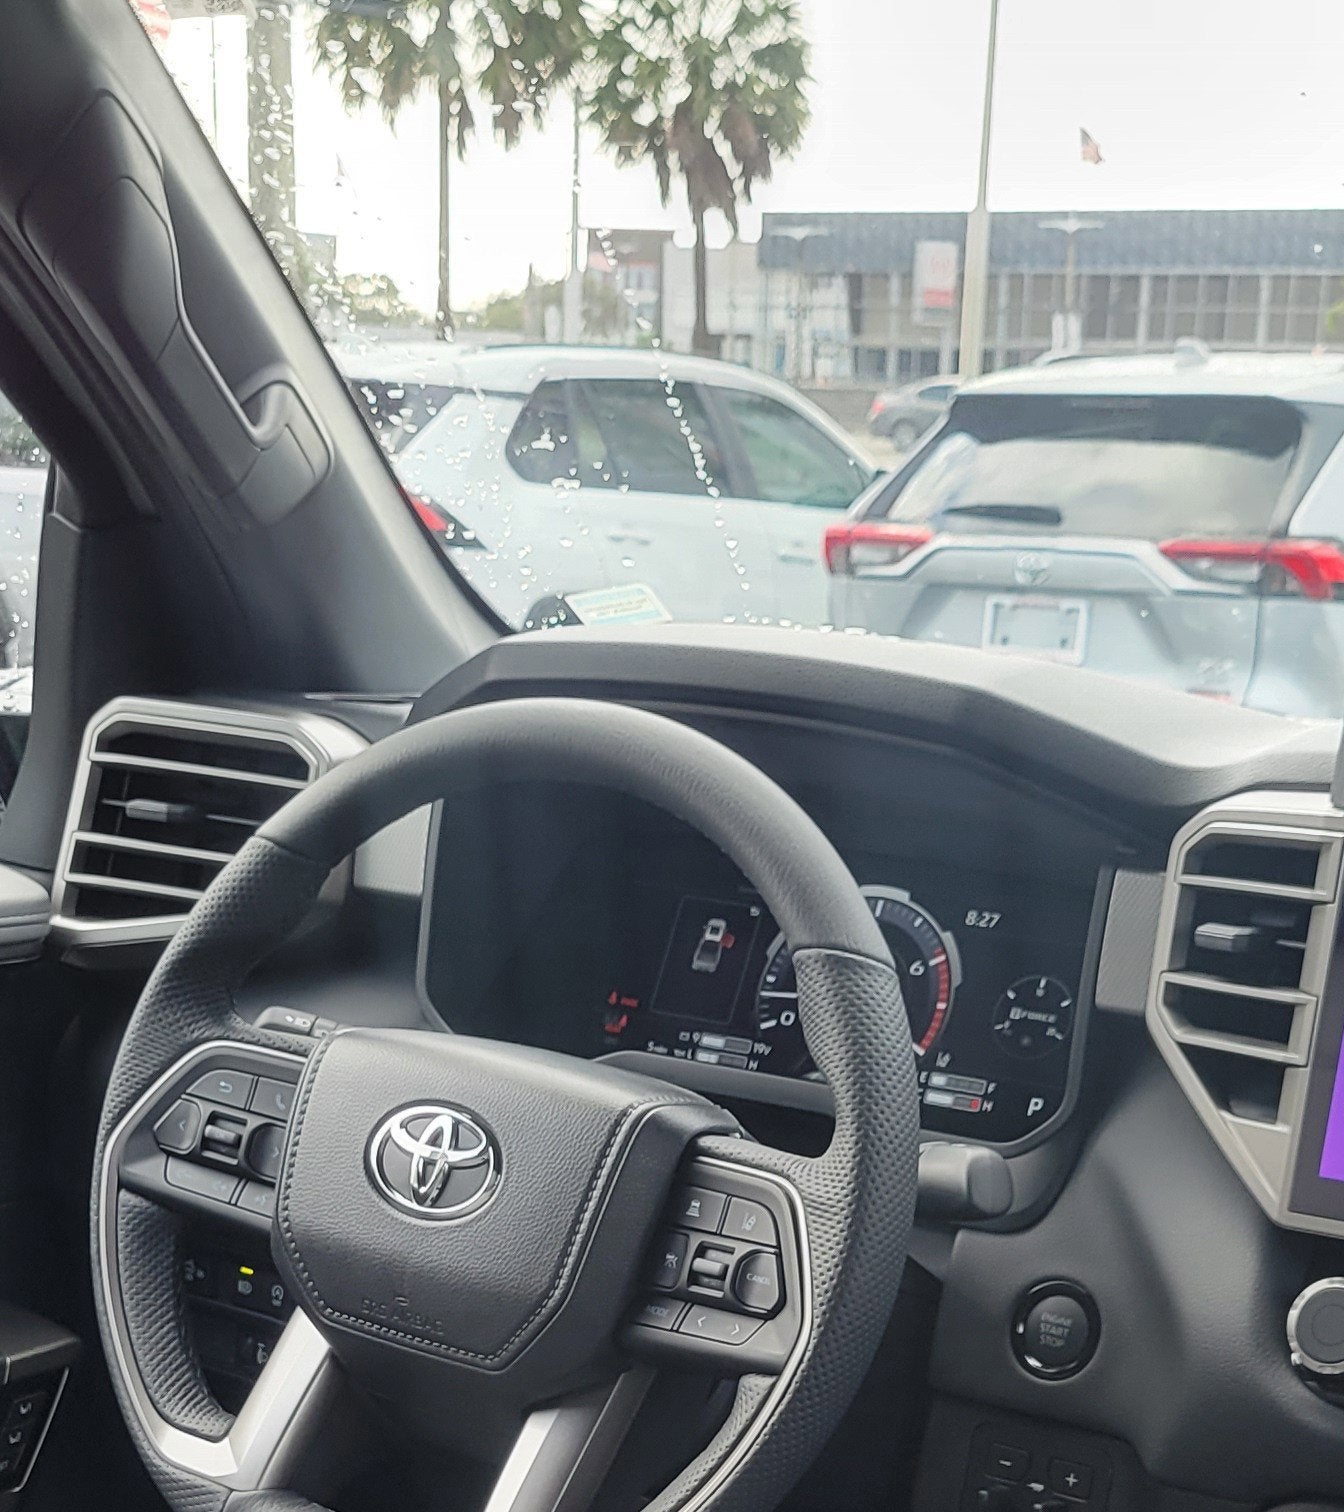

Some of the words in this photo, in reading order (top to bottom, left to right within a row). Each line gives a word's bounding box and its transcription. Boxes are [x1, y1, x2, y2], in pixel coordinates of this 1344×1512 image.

[964, 909, 1001, 928] 8:27
[909, 959, 926, 976] 6
[779, 1009, 796, 1027] 0
[1026, 1097, 1045, 1117] P
